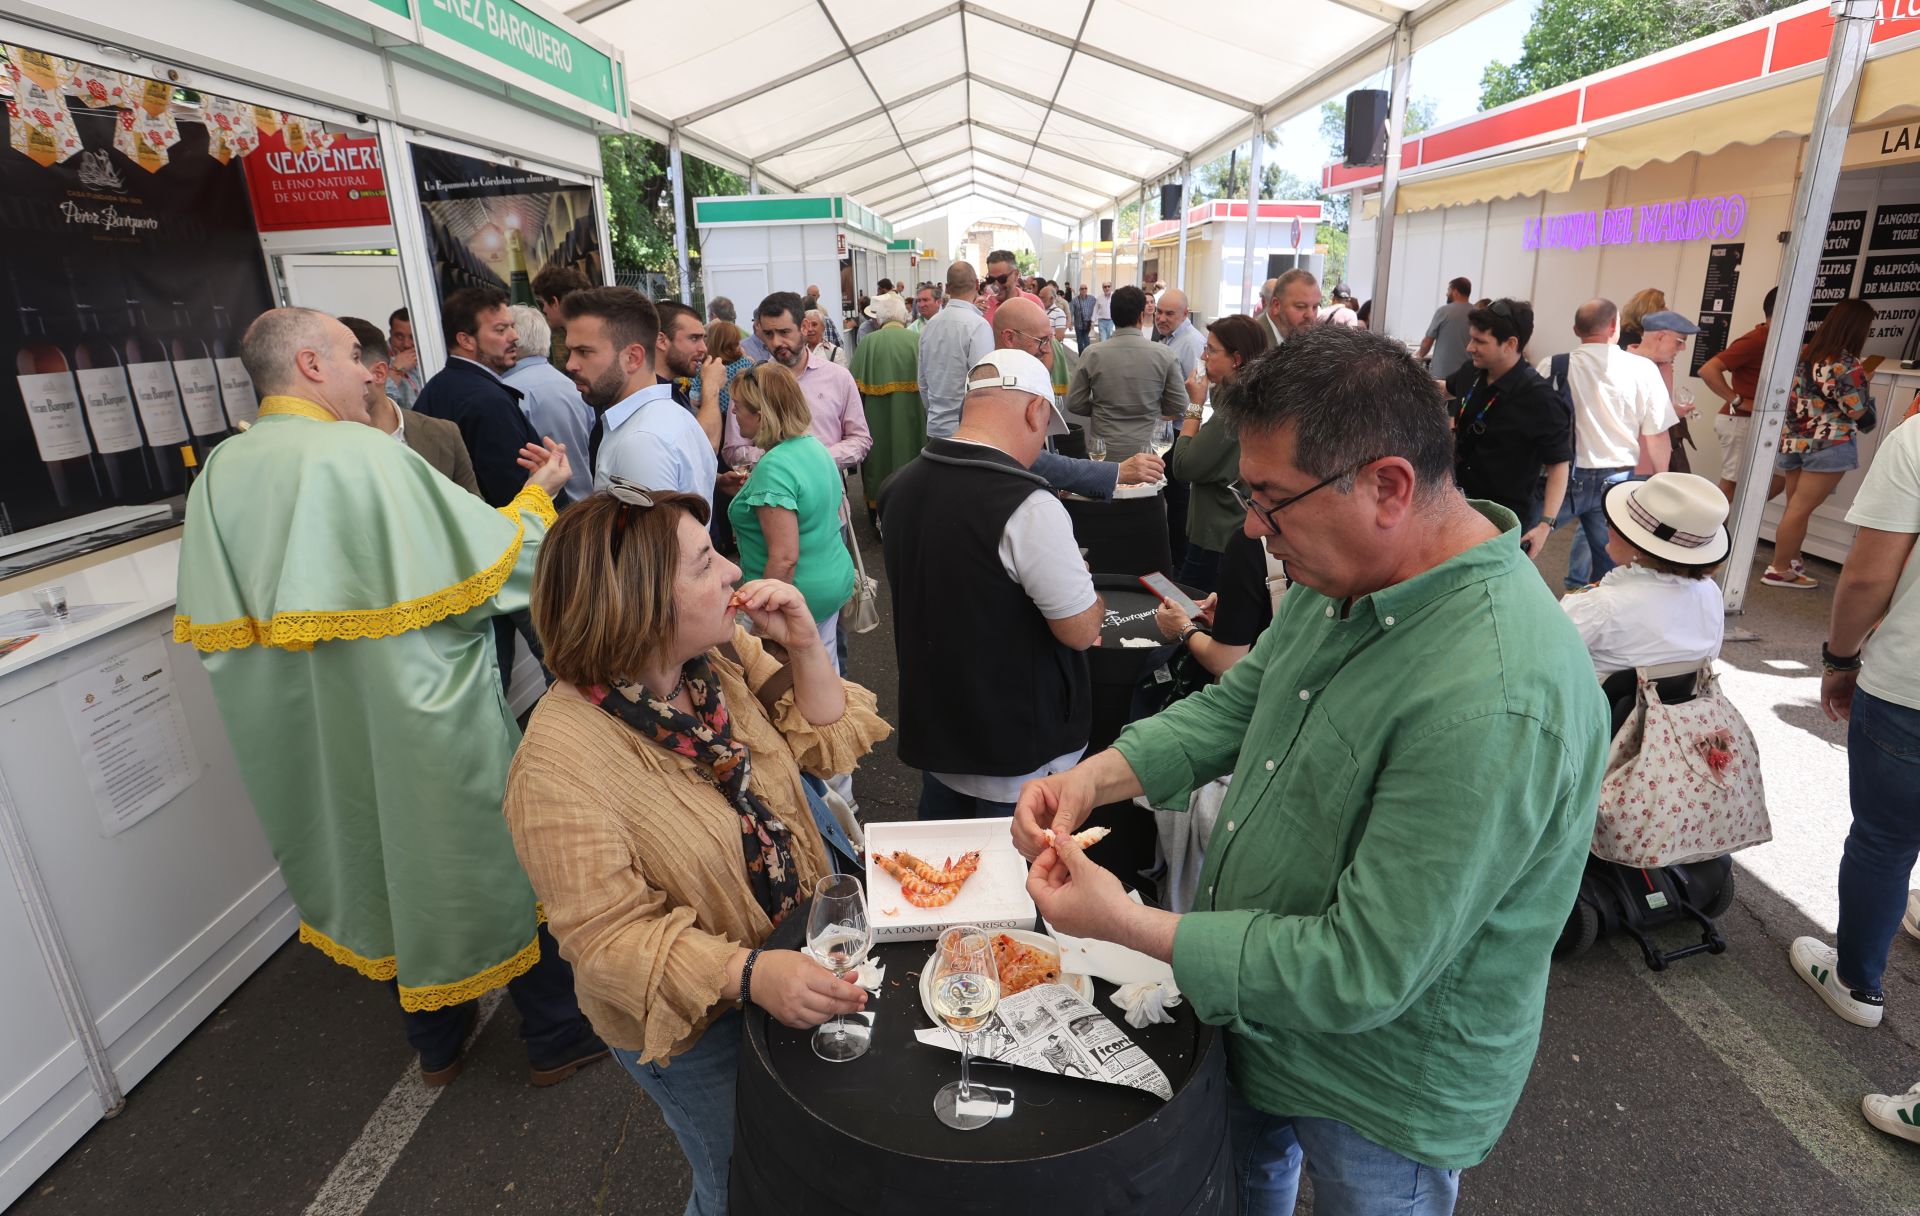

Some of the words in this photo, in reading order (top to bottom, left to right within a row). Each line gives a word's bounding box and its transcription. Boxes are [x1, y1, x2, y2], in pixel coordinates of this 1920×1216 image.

[433, 0, 485, 30] EZ
[485, 0, 573, 73] BARQUERO
[1881, 127, 1910, 154] LA
[272, 180, 284, 190] EL
[287, 179, 315, 190] FINO
[317, 176, 368, 187] NATURAL
[435, 179, 470, 192] Espumoso
[470, 179, 479, 187] de
[479, 175, 512, 186] Córdoba
[526, 174, 544, 183] alma
[274, 193, 288, 203] DE
[292, 191, 306, 202] SU
[308, 190, 339, 201] COPA
[100, 204, 158, 235] Barquero
[1522, 217, 1541, 250] LA
[1544, 210, 1597, 250] LONJA
[1600, 206, 1634, 245] DEL
[1637, 193, 1745, 243] MARISCO
[1829, 219, 1861, 231] ADITO
[1892, 229, 1919, 241] TIGRE
[1824, 236, 1850, 250] ATÚN
[1873, 260, 1920, 275] SALPICÓN
[1864, 282, 1878, 293] DE
[1872, 309, 1916, 320] NTADITO
[1877, 325, 1905, 337] ATÚN
[896, 926, 933, 935] LONJA
[969, 920, 1017, 930] ARISCO
